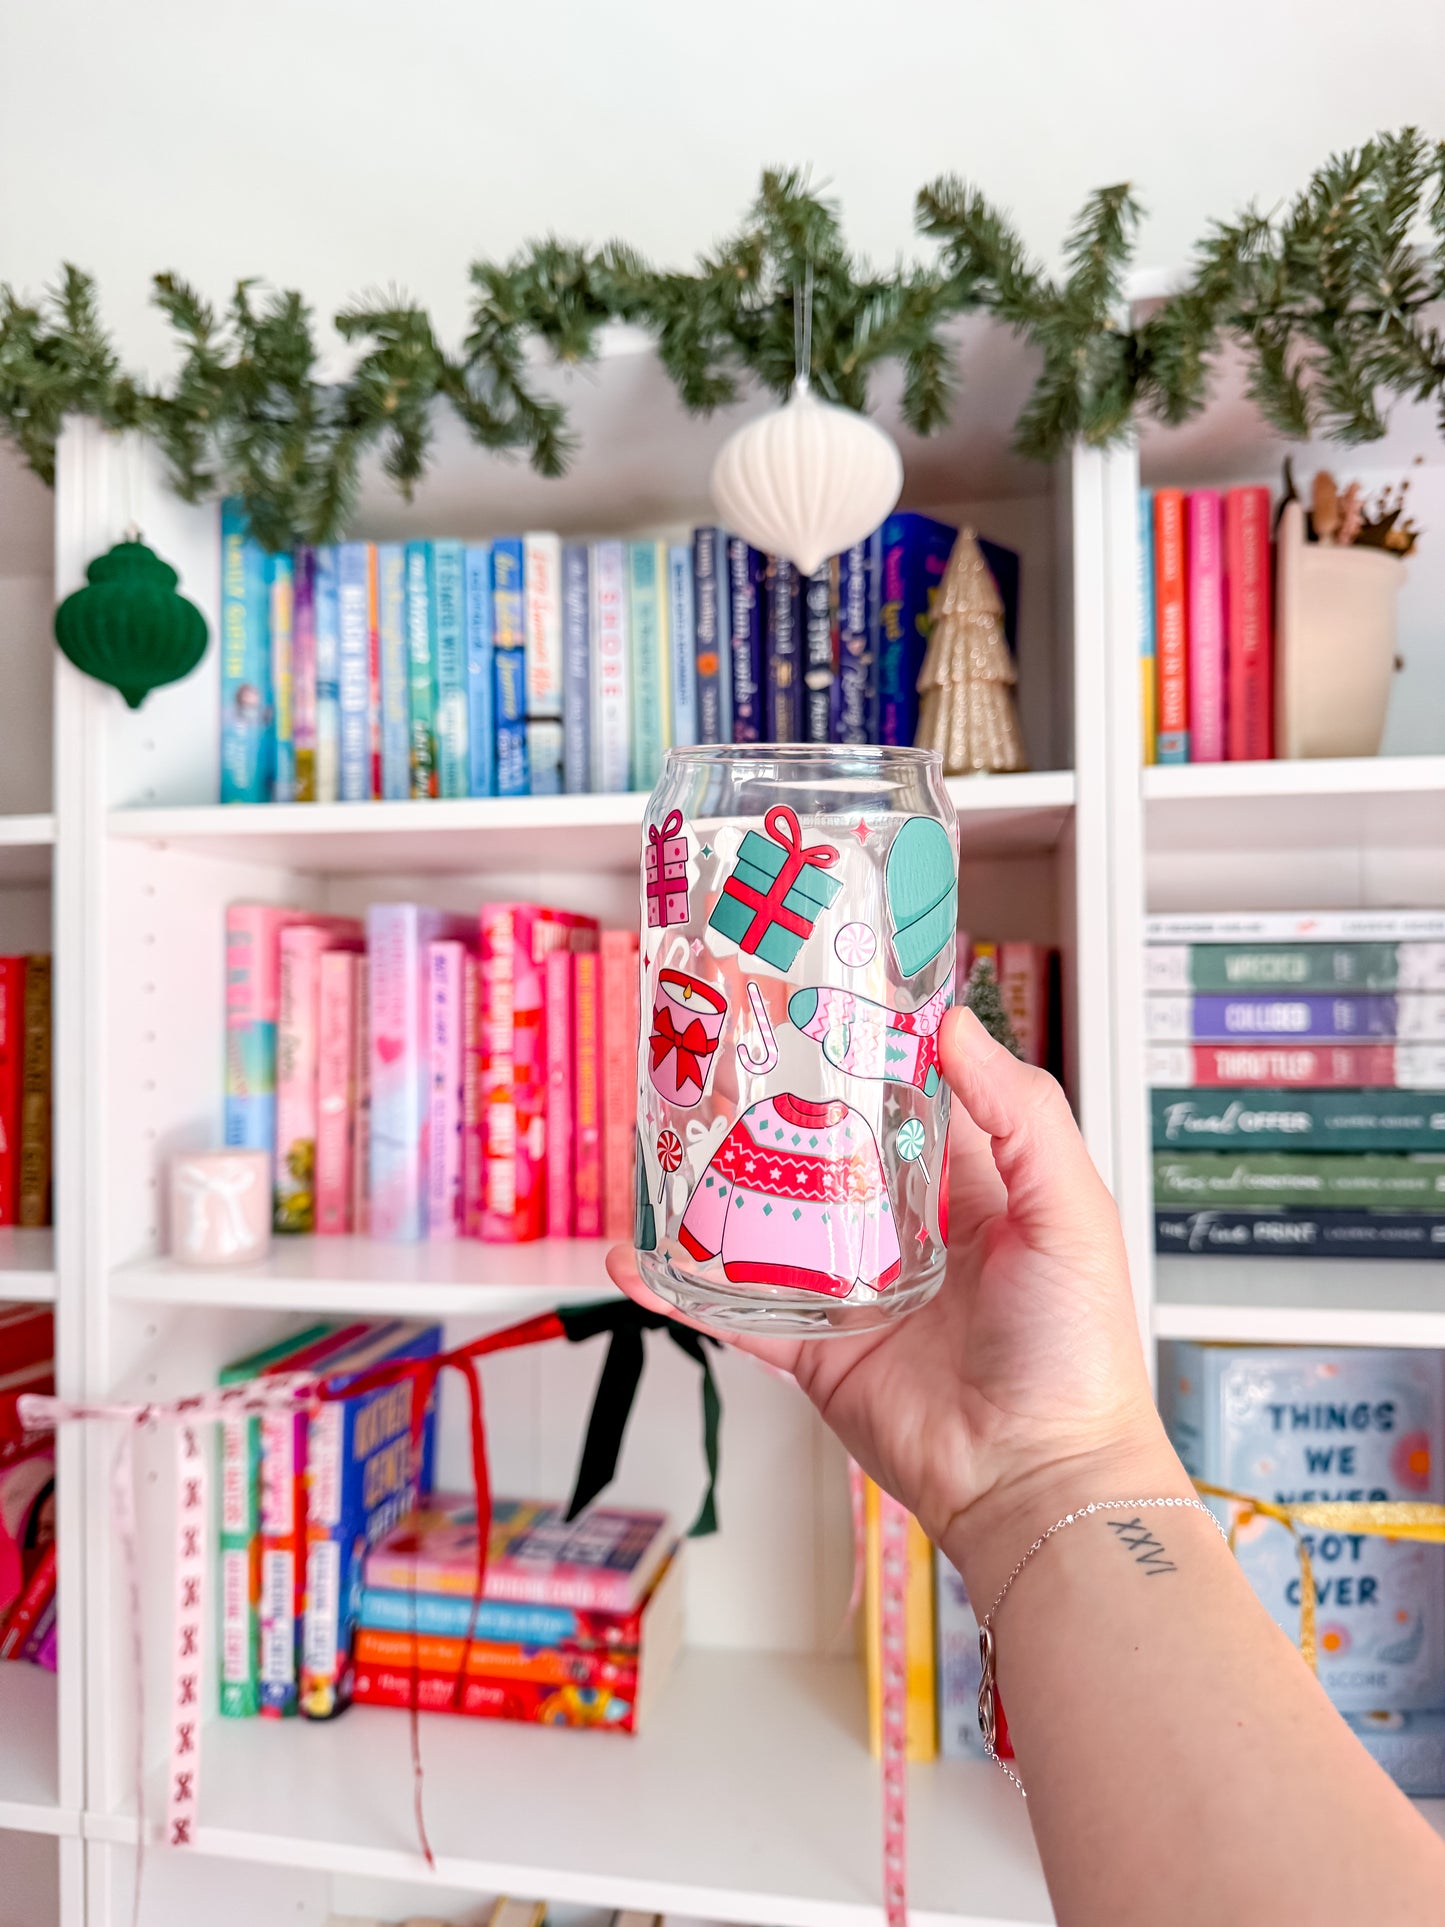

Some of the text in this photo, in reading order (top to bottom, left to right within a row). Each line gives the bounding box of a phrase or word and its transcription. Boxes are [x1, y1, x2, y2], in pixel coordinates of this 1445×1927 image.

[1237, 1110, 1313, 1133] OFFER
[1267, 1402, 1398, 1432] THINGS
[1304, 1445, 1358, 1475] WE
[1107, 1517, 1178, 1577] XXVI
[1297, 1534, 1368, 1562] GOT
[1285, 1576, 1380, 1607] OVER
[1327, 1670, 1389, 1689] SCORE
